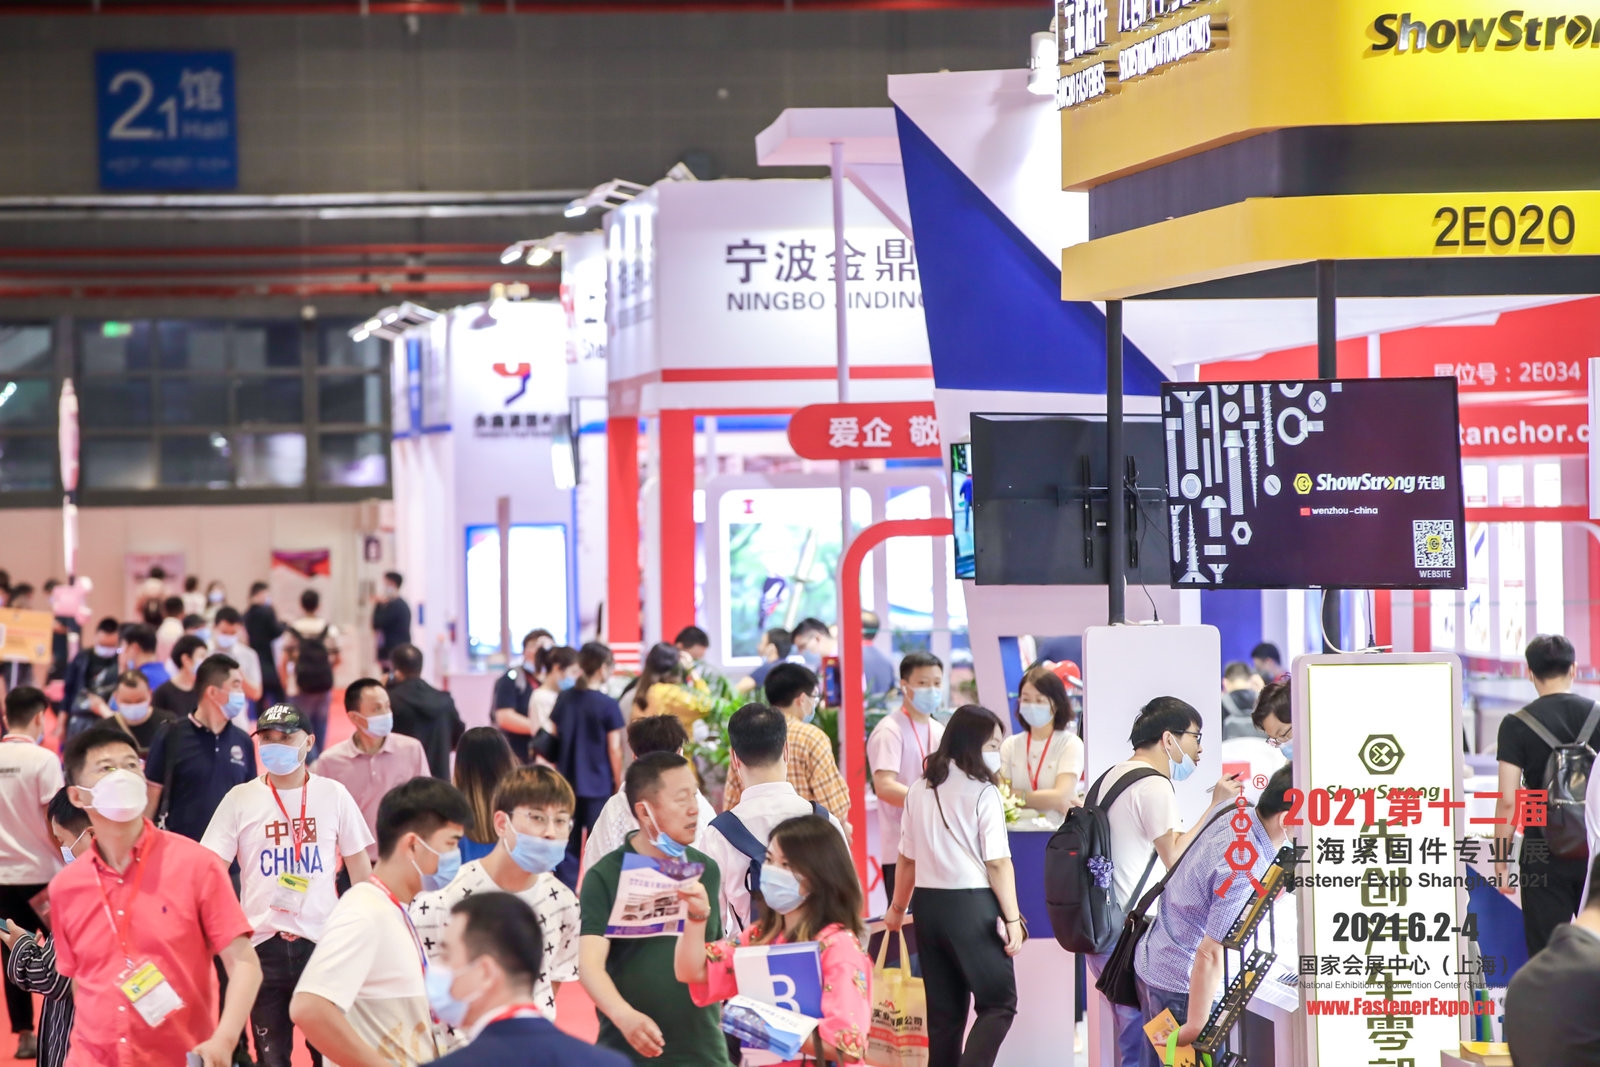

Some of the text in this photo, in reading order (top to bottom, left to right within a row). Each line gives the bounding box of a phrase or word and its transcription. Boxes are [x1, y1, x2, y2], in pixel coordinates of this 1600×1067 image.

[1372, 10, 1600, 50] ShowStro
[180, 68, 222, 111] 馆
[181, 120, 229, 139] Hall
[1434, 204, 1575, 247] 2E020
[726, 239, 916, 284] 宁波金鼎
[727, 291, 925, 311] NINGBO INDIN
[829, 417, 892, 448] 爱企
[1316, 473, 1446, 494] ShowStrong 先创
[1419, 569, 1452, 578] WEBSITE
[260, 845, 323, 877] CHINA
[1359, 818, 1417, 1067] 先创汽车零
